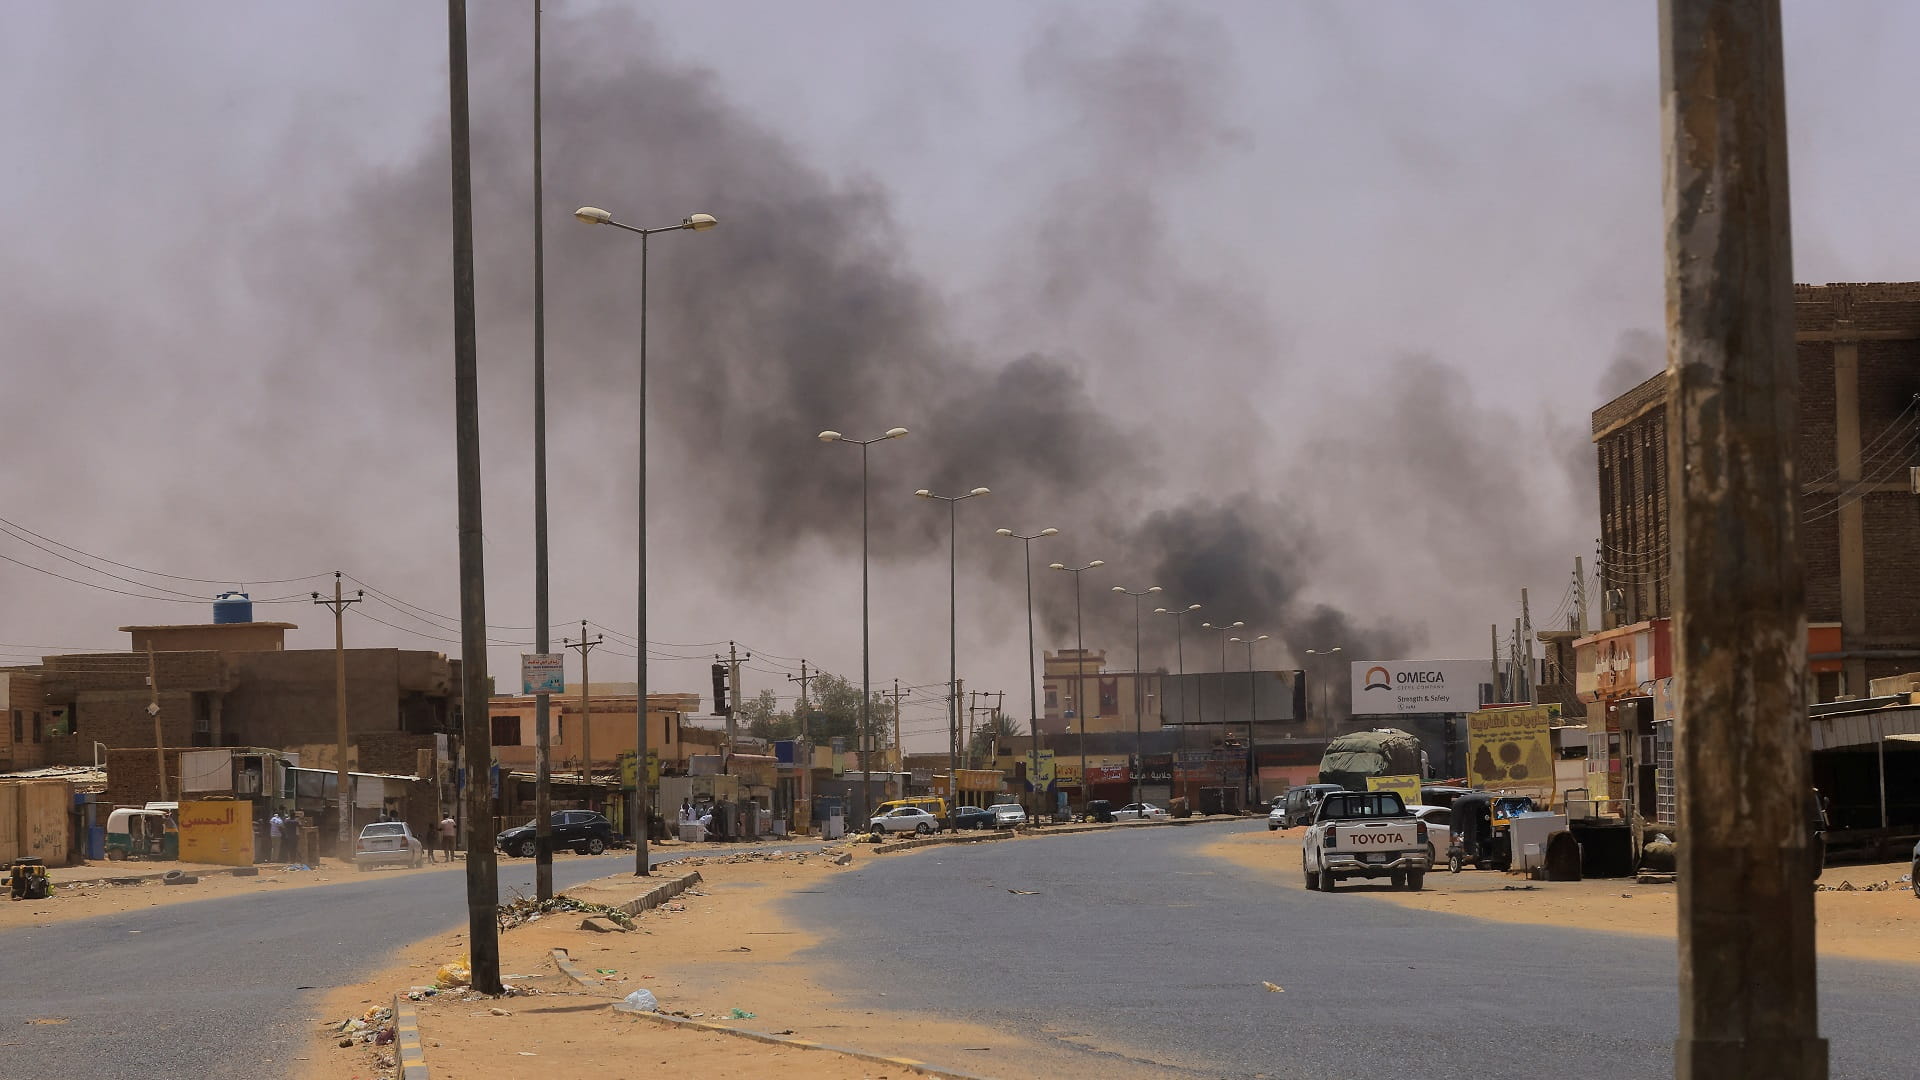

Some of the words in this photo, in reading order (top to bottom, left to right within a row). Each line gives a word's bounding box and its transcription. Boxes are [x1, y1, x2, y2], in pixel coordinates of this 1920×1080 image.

[1396, 671, 1445, 684] OMEGA
[1397, 695, 1423, 703] Strength
[1430, 694, 1450, 702] Safety
[1350, 833, 1404, 845] TOYOTA
